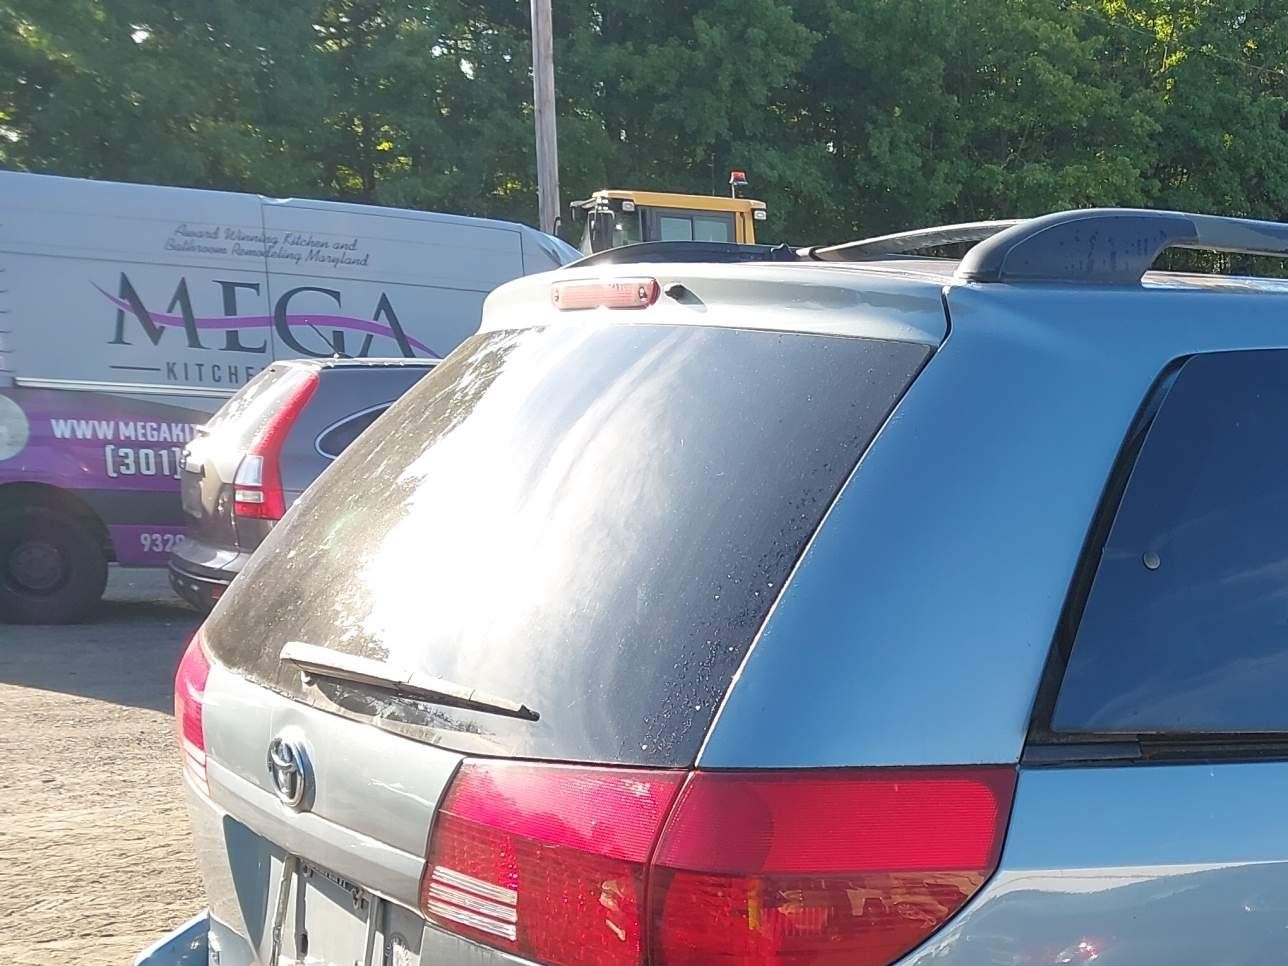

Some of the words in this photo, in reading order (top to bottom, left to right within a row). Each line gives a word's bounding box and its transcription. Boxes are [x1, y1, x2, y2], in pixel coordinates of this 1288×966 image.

[283, 232, 329, 249] Kitchen
[332, 239, 359, 251] and
[304, 249, 370, 268] Maryland
[106, 271, 416, 359] MEGA
